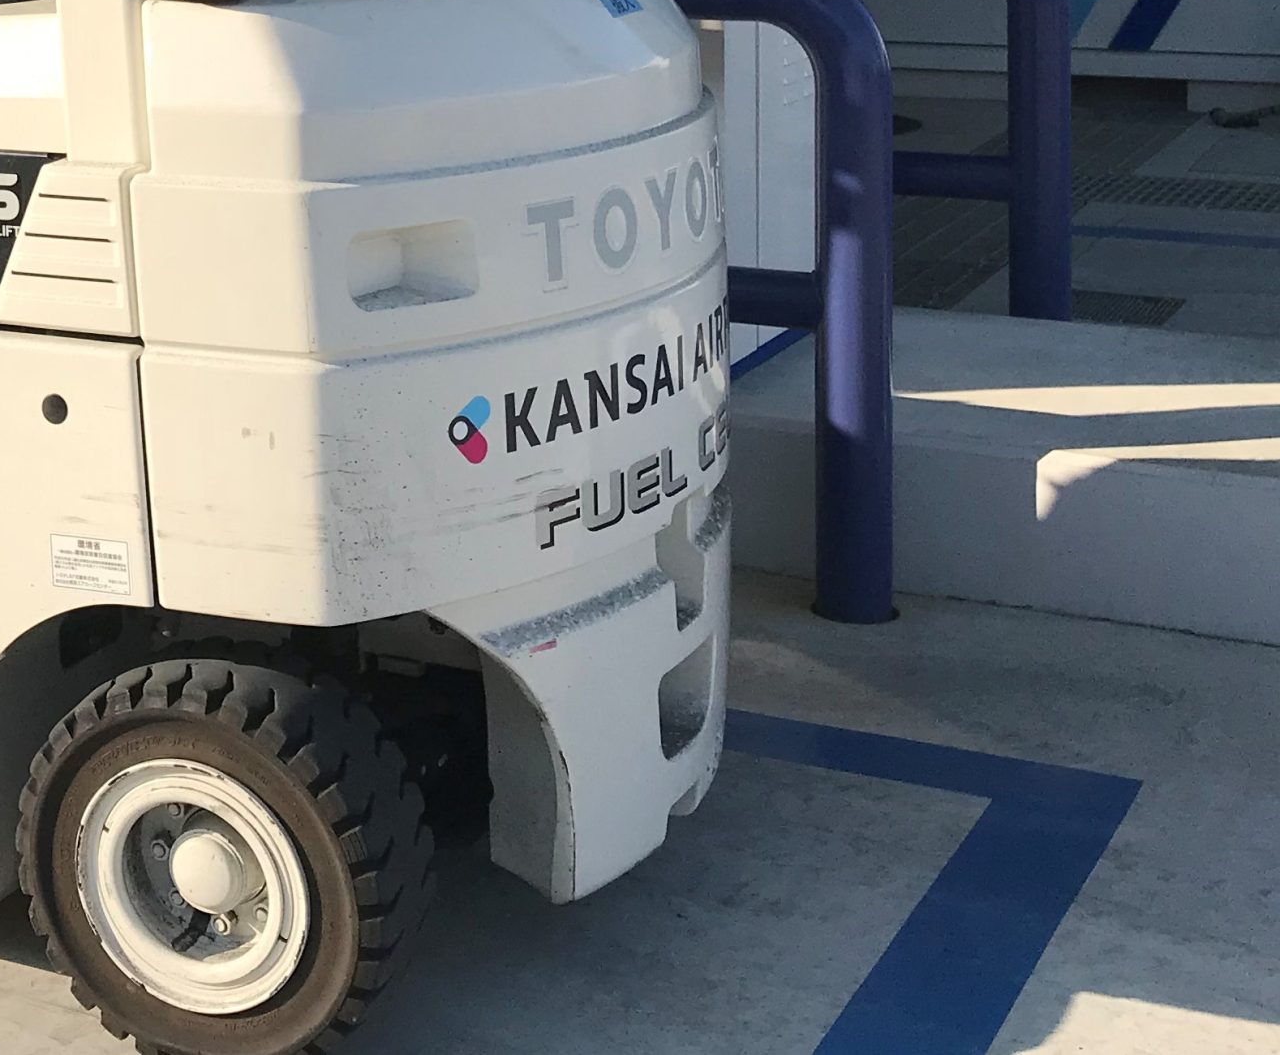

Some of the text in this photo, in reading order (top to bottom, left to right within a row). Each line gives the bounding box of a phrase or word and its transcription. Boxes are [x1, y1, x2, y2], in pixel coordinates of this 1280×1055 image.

[504, 333, 685, 454] KANSAI
[535, 403, 731, 551] FUEL CE
